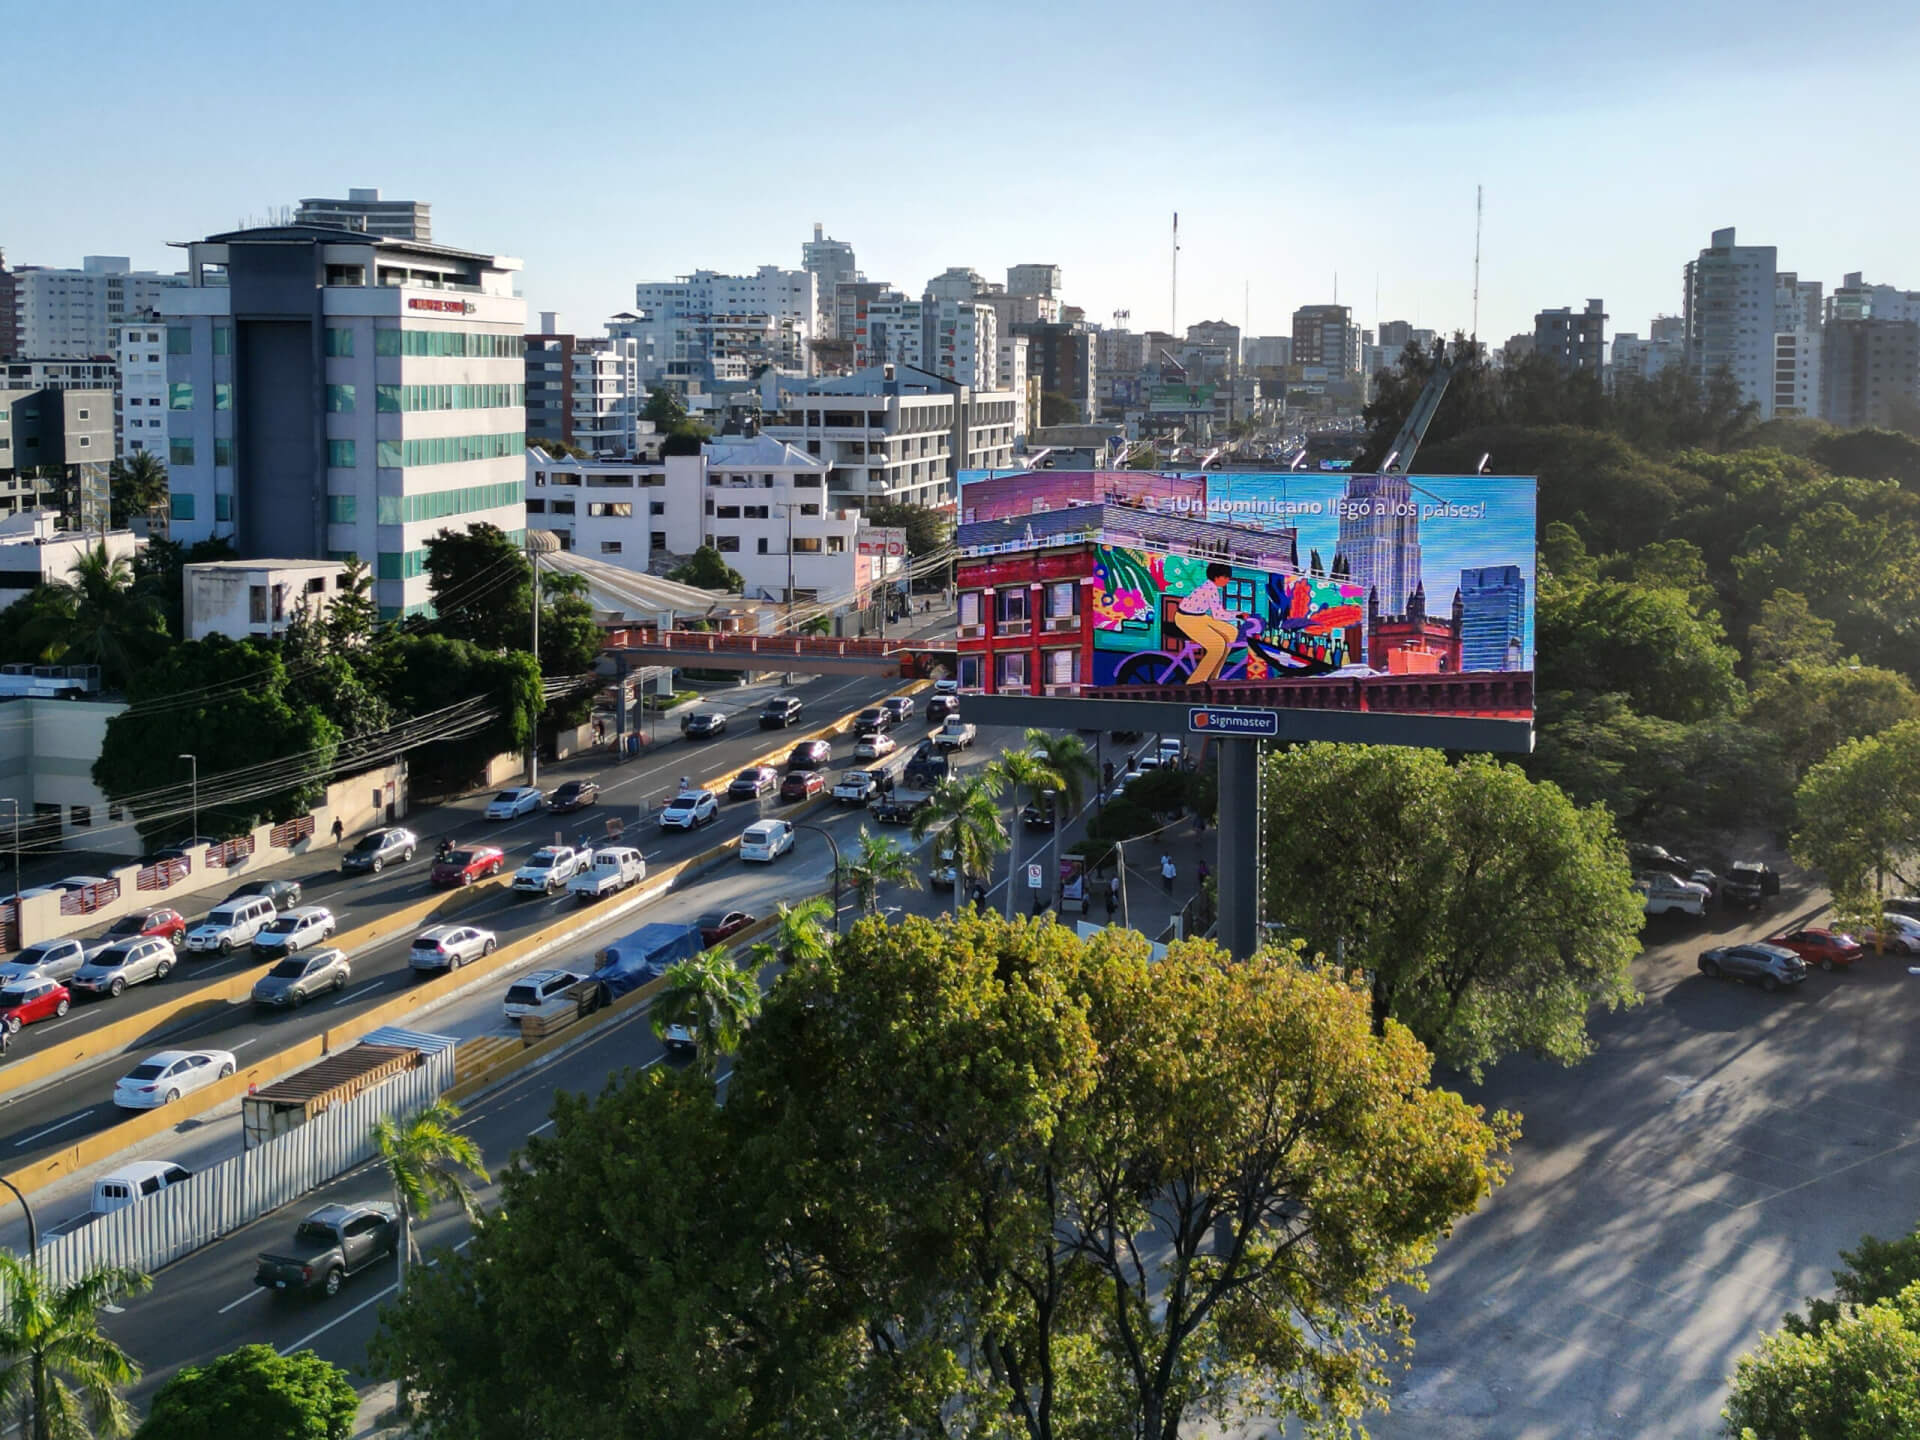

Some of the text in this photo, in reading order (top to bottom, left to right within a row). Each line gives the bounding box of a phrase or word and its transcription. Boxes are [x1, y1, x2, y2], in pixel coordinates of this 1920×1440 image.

[1207, 496, 1323, 514] dominicano
[1328, 498, 1370, 520] llegó
[1375, 503, 1386, 515] a
[1391, 499, 1417, 517] los
[1423, 500, 1486, 521] países!
[1210, 714, 1272, 728] Signmaster
